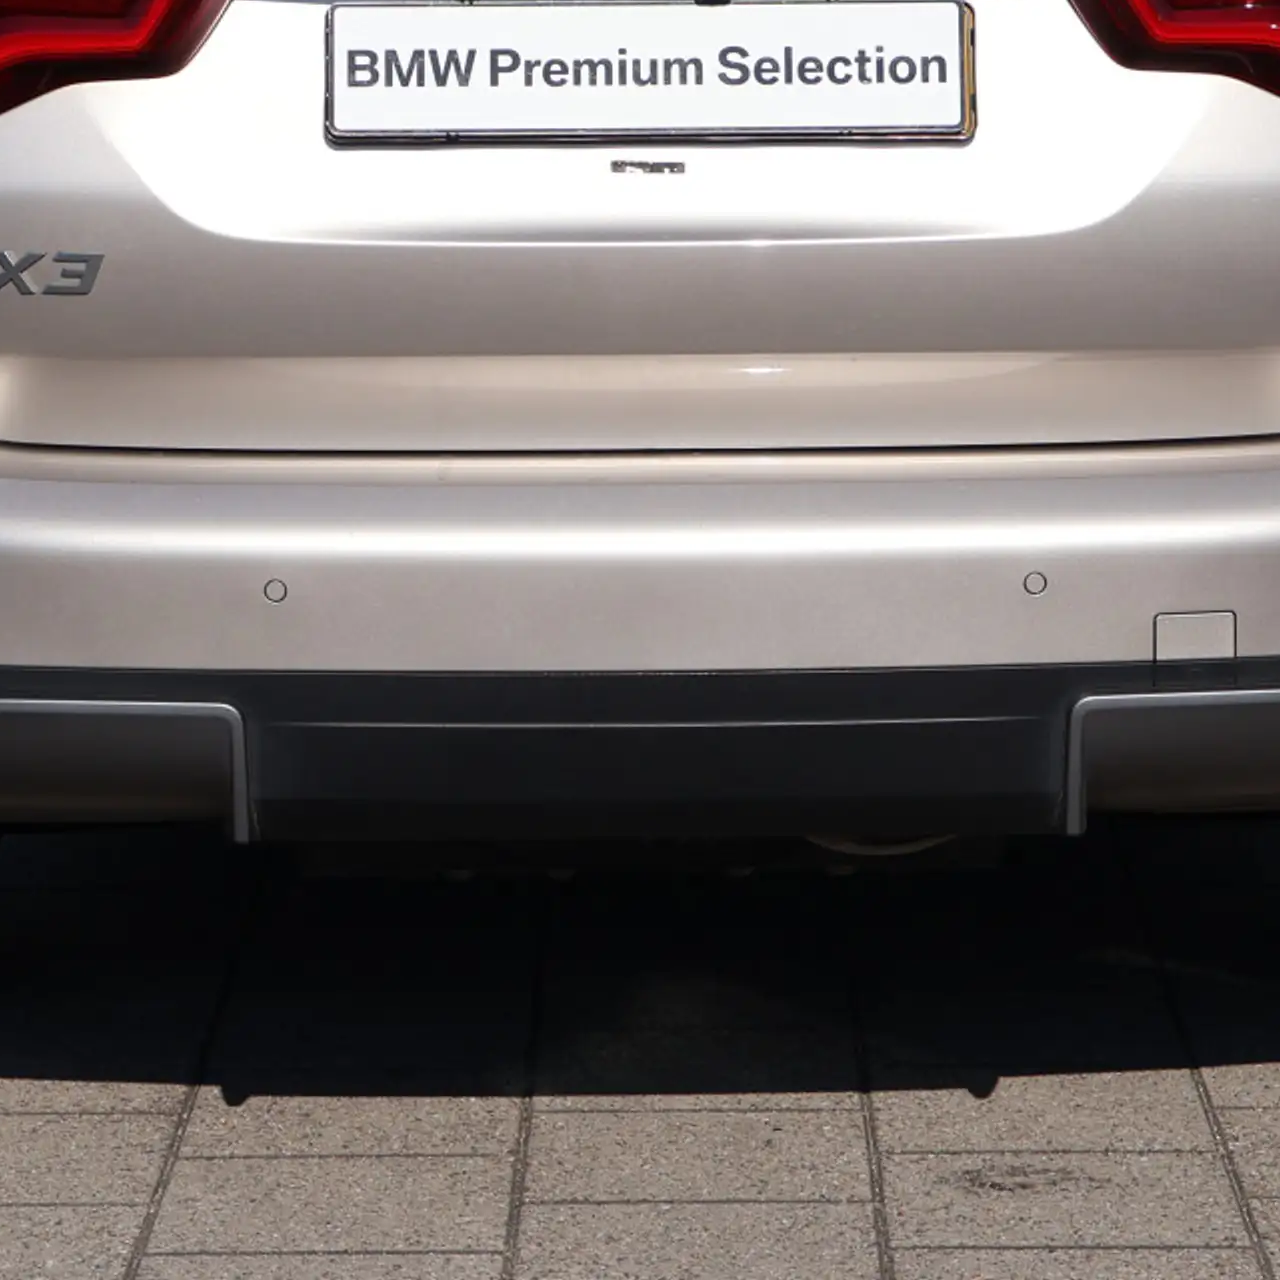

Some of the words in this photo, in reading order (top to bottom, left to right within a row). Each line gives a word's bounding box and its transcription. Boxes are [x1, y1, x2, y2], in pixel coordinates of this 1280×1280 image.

[346, 48, 478, 88] BMW
[488, 47, 704, 88] Premium
[717, 45, 949, 86] Selection
